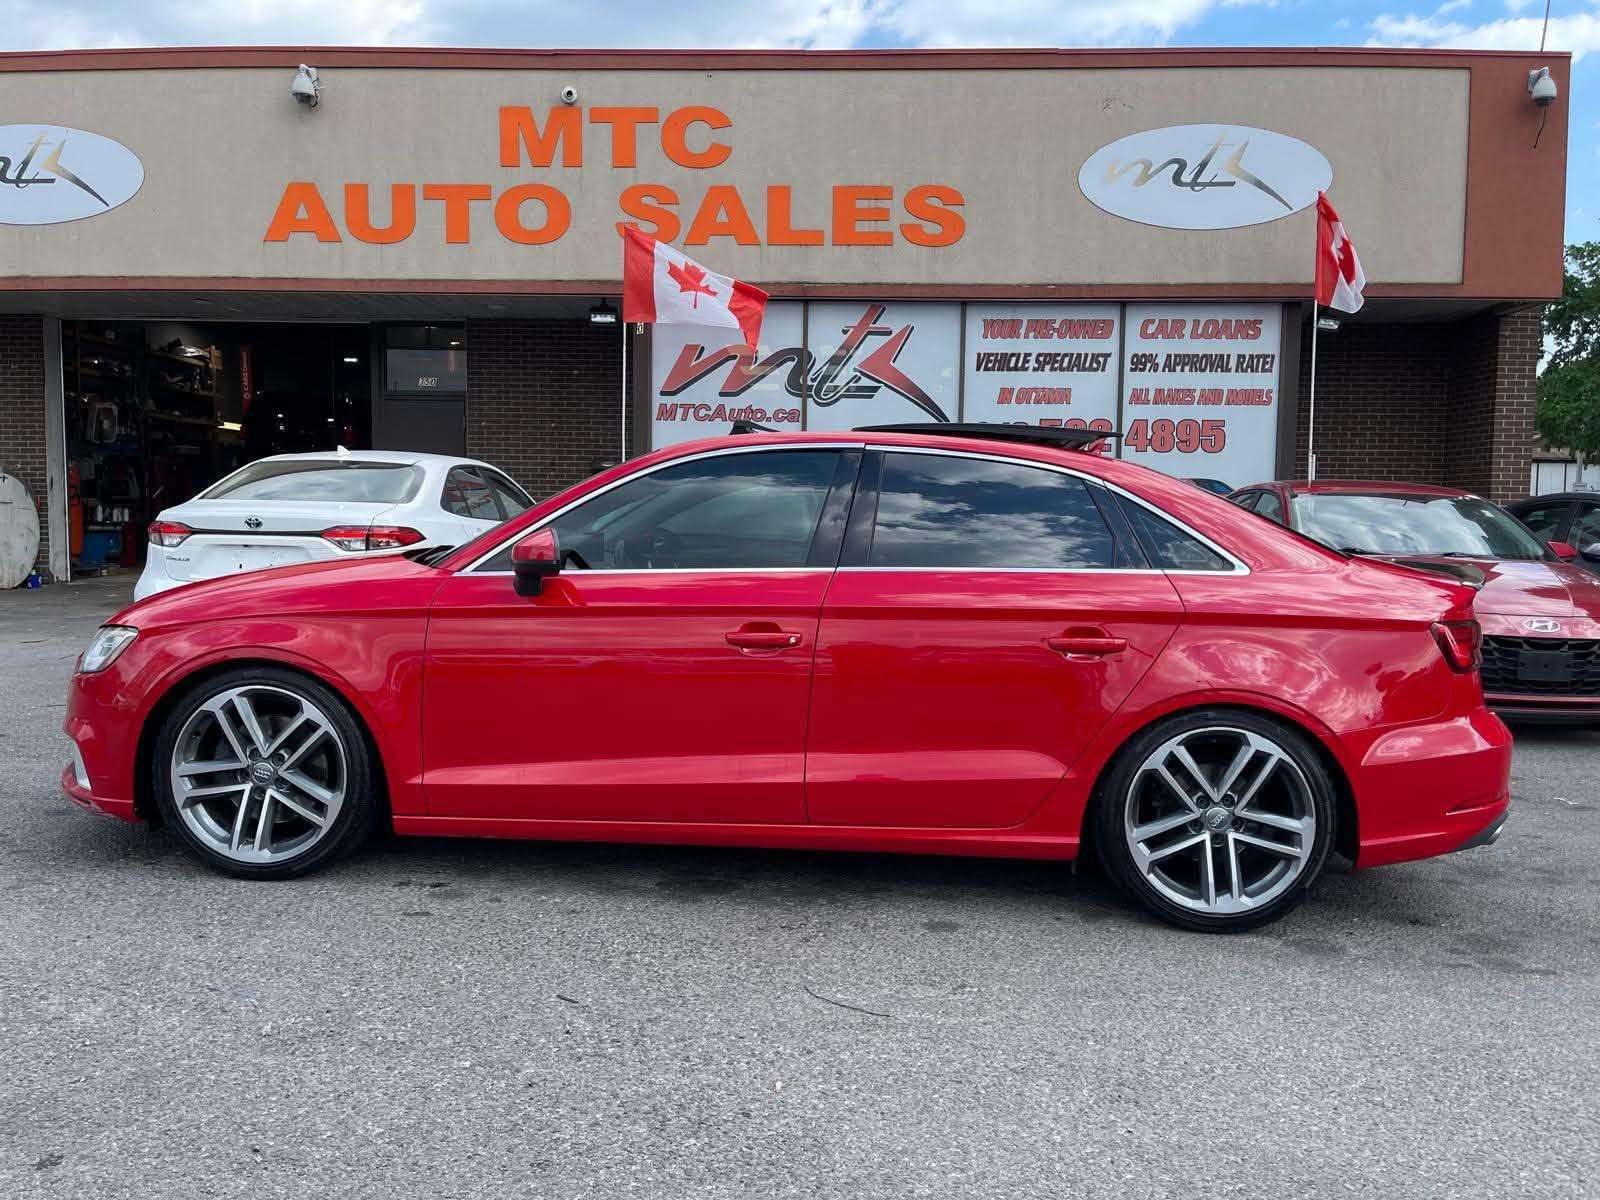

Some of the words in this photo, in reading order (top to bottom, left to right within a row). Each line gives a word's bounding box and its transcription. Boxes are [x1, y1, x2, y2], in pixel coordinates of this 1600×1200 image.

[501, 105, 733, 169] MTC
[264, 182, 572, 244] AUTO
[615, 184, 966, 247] SALES
[982, 318, 1023, 340] YOUR
[1023, 318, 1115, 340] PRE-OWNED
[1139, 318, 1187, 340] CAR
[1190, 318, 1264, 340] LOANS
[976, 352, 1032, 372] VEHICLE
[1031, 352, 1112, 373] SPECIALIST
[1129, 353, 1160, 373] 99%
[1161, 353, 1232, 373] APPROVAL
[1234, 353, 1276, 373] RATE!
[996, 387, 1015, 405] IN
[1014, 387, 1072, 405] OTTAWA
[1128, 387, 1151, 406] ALL
[1151, 387, 1197, 406] MAKES
[1196, 388, 1225, 406] AND
[1222, 388, 1274, 406] MODELS
[655, 402, 801, 423] MTCAuto.ca
[1124, 418, 1227, 454] 4895
